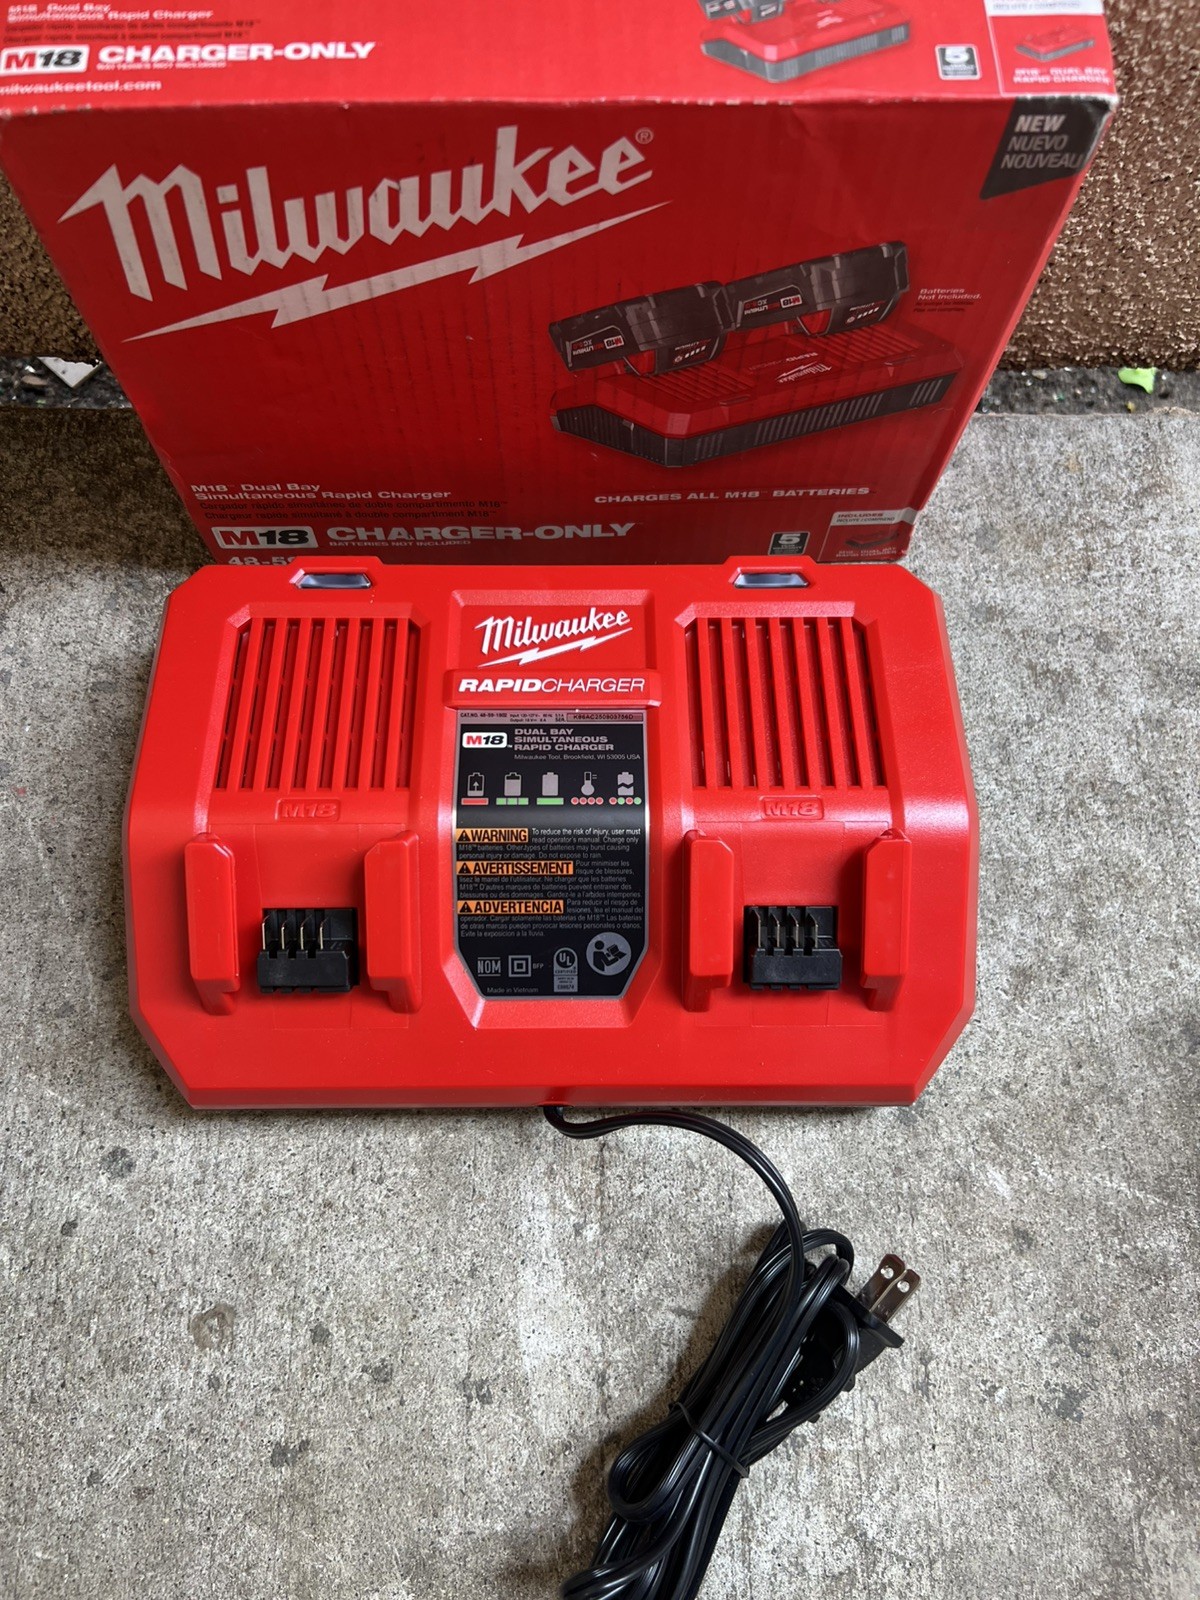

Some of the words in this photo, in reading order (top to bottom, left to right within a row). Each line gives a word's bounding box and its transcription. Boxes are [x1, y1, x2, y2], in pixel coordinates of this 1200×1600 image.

[4, 50, 83, 70] M18
[98, 42, 377, 64] CHARGER-ONLY
[1014, 114, 1066, 133] NEW
[1007, 134, 1069, 152] NUEVO
[1000, 152, 1084, 169] NOUVEAU
[240, 484, 282, 492] Dual
[286, 483, 321, 493] Bay
[194, 491, 317, 501] Simultaneous
[321, 491, 373, 501] Rapid
[377, 490, 452, 501] Charger
[594, 493, 683, 504] CHARGES
[686, 491, 720, 501] ALL
[772, 487, 871, 498] BATTERIES
[216, 529, 312, 547] M18
[326, 523, 637, 543] CHARGER-ONLY
[777, 533, 802, 545] 5
[329, 540, 389, 548] BATTERIES
[391, 540, 415, 548] NOT
[417, 539, 472, 548] INCLUDED
[227, 556, 298, 567] 48-5
[475, 607, 631, 656] Milwaukee
[514, 728, 548, 736] DUAL
[550, 728, 574, 736] BAY
[465, 734, 506, 747] M18
[514, 736, 609, 744] SIMULTANEOUS
[281, 802, 338, 818] M18
[763, 800, 819, 817] M18
[470, 829, 528, 842] WARNING
[602, 836, 625, 844] Charge
[626, 836, 639, 844] only
[473, 862, 572, 874] AVERTISSEMENT
[474, 901, 563, 914] ADVERTENCIA
[477, 960, 501, 974] NOM
